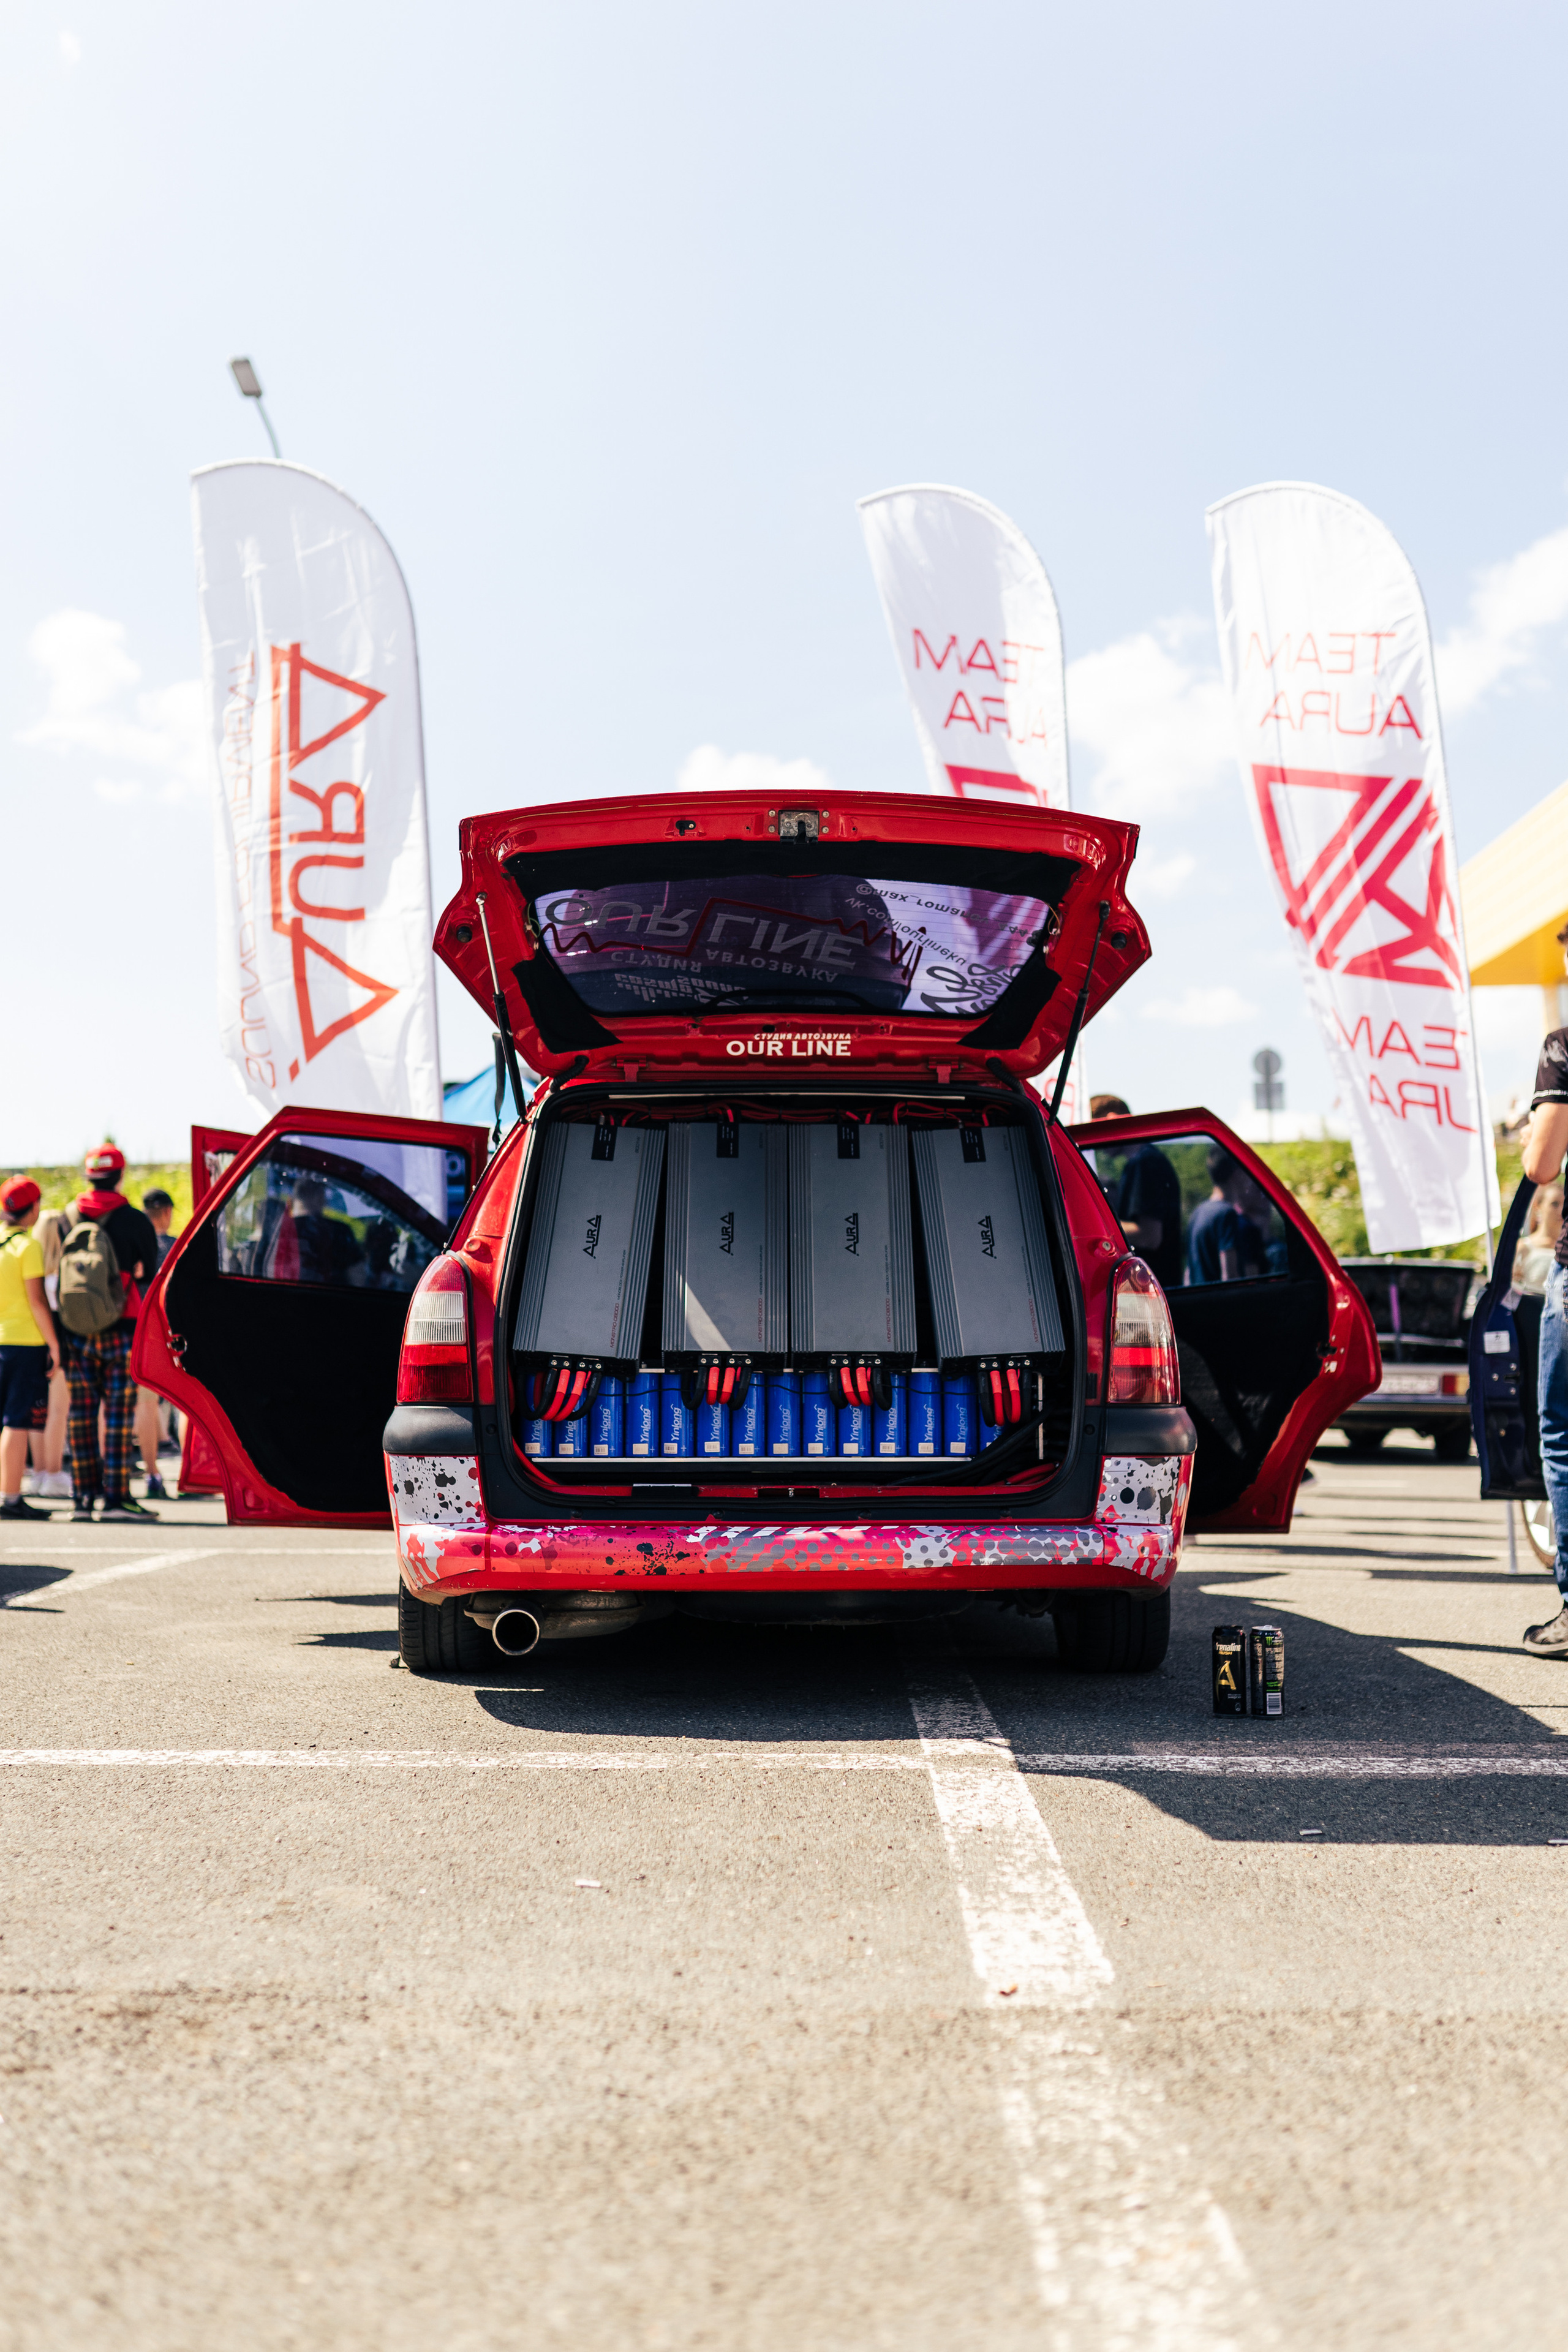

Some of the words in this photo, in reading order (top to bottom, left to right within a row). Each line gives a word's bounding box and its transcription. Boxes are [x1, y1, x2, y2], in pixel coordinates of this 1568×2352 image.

[726, 1041, 783, 1057] OUR
[792, 1040, 851, 1057] LINE
[582, 1215, 602, 1259] AURA
[719, 1212, 734, 1256] AURA
[845, 1212, 859, 1257] AURA
[978, 1215, 997, 1259] AURA
[532, 1418, 541, 1441] Yinlo
[565, 1420, 574, 1442] Yinlo
[600, 1408, 611, 1442] Yinlong
[641, 1408, 651, 1442] Yinlong
[671, 1407, 682, 1441] Yinlong
[710, 1406, 721, 1441] Yinlong
[744, 1408, 755, 1442] Yinlong
[780, 1408, 790, 1442] Yinlong
[815, 1408, 826, 1442] Yinlong
[850, 1407, 861, 1441] Yinlong
[886, 1407, 896, 1441] Yinlong
[924, 1408, 934, 1441] Yinlong
[957, 1407, 967, 1441] Yinlong
